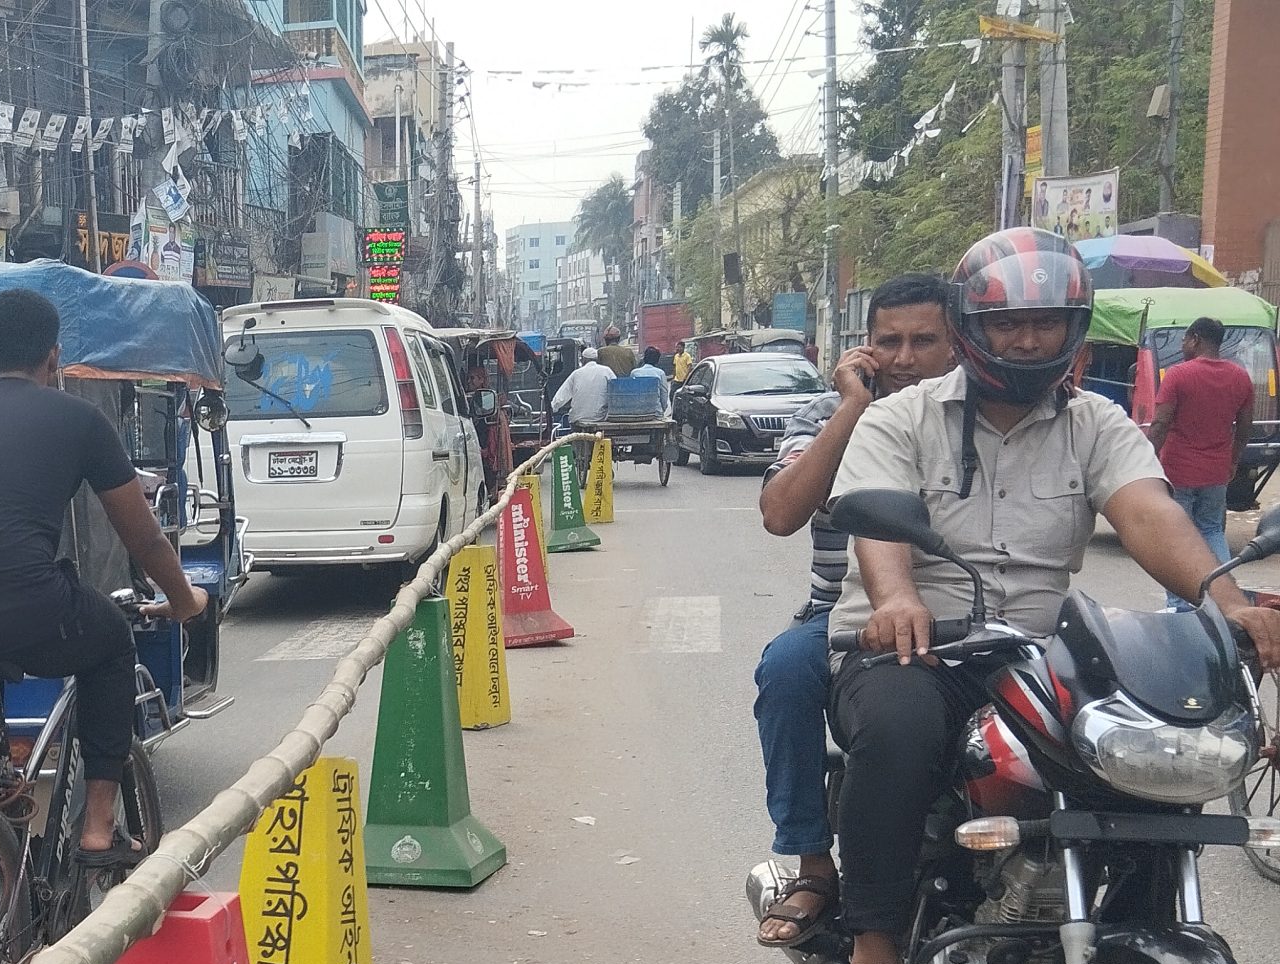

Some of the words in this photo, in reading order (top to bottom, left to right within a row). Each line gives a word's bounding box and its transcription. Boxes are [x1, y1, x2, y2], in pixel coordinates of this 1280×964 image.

[559, 455, 573, 510] minister
[511, 503, 530, 583] minister
[511, 583, 539, 594] Smart
[519, 592, 532, 600] TV
[56, 737, 81, 864] DURANTA
[266, 774, 310, 856] শহর
[332, 768, 357, 876] ট্রাফিক
